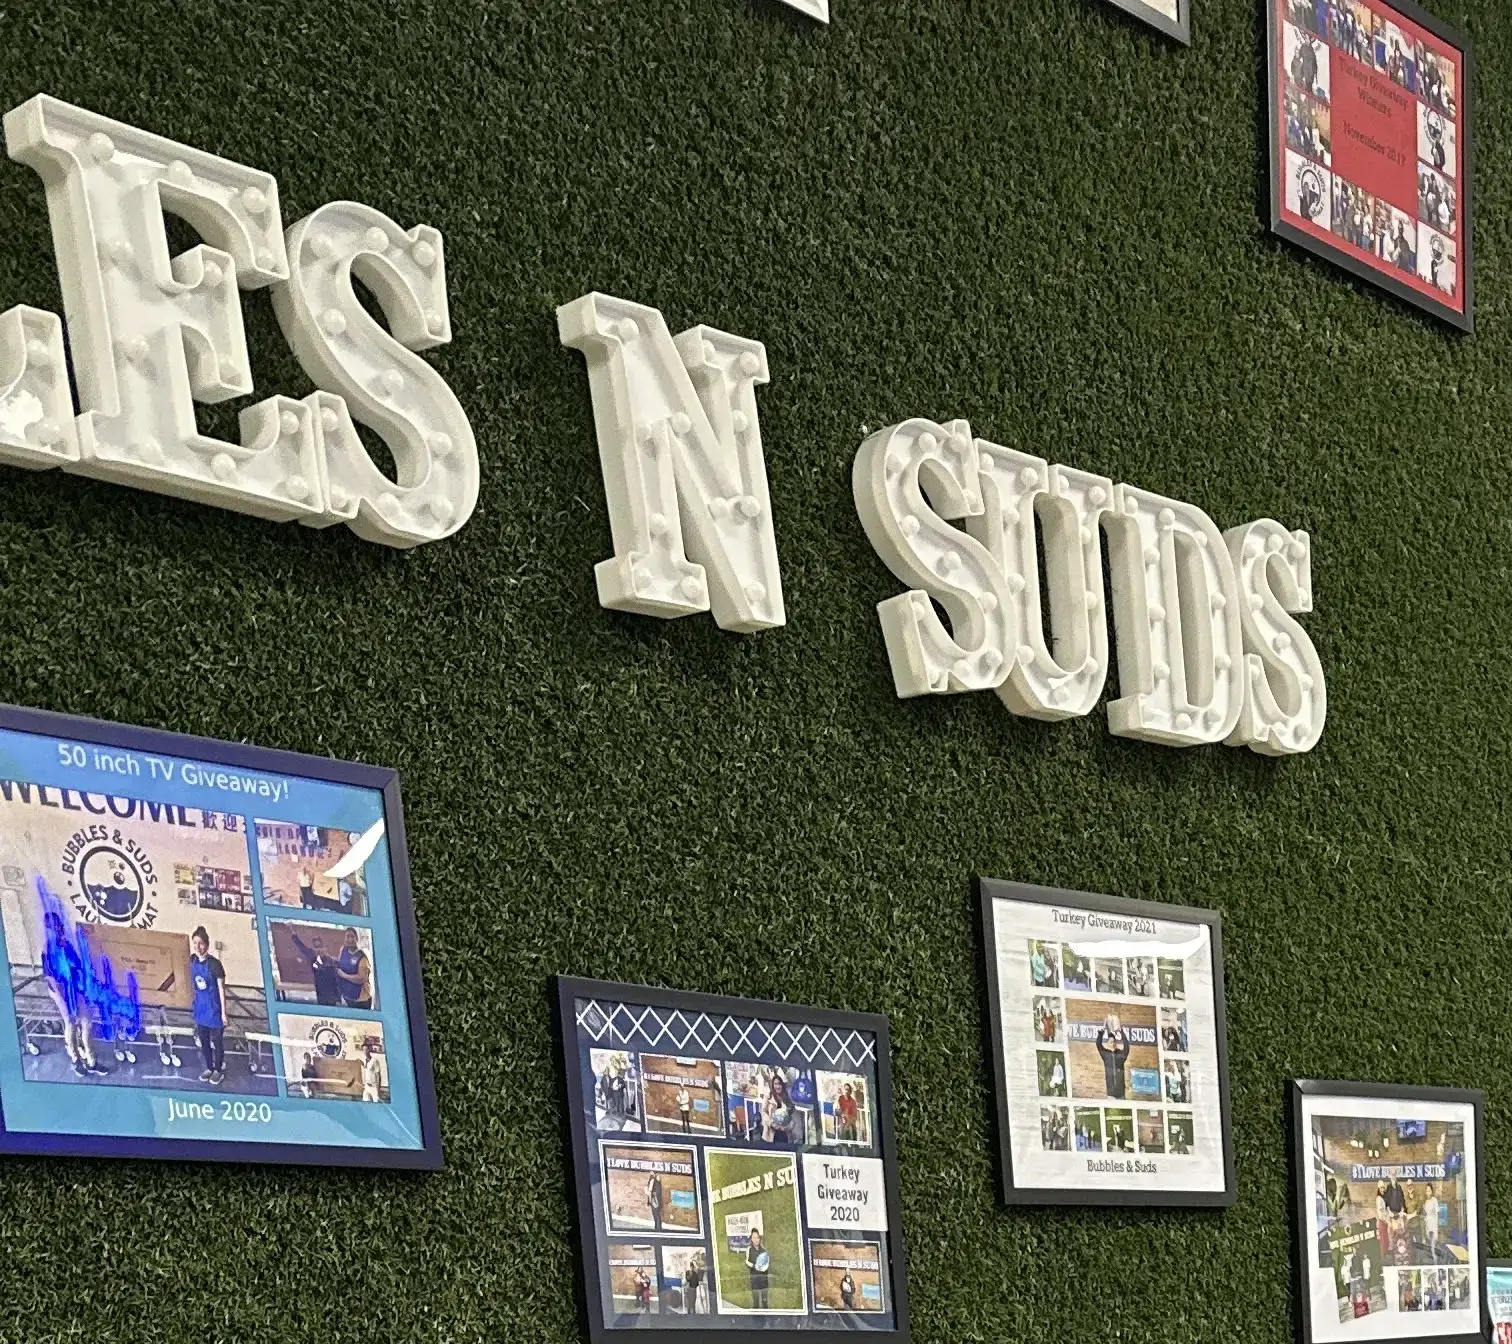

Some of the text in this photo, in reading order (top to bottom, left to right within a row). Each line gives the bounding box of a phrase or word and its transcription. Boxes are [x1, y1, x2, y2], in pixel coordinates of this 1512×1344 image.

[556, 291, 786, 633] N
[852, 418, 1327, 757] SUDS
[58, 743, 289, 802] 50 inch TV Giveaway!
[61, 824, 158, 885] BUBBLES & SUDS
[1051, 908, 1157, 935] Turkey Giveaway 2021
[1131, 1027, 1156, 1042] SUDS
[168, 1097, 272, 1123] June 2020
[823, 1164, 860, 1183] Turkey
[1087, 1159, 1157, 1173] Bubbles & Suds
[763, 1172, 774, 1190] N
[817, 1185, 868, 1205] Giveaway
[830, 1206, 860, 1221] 2020
